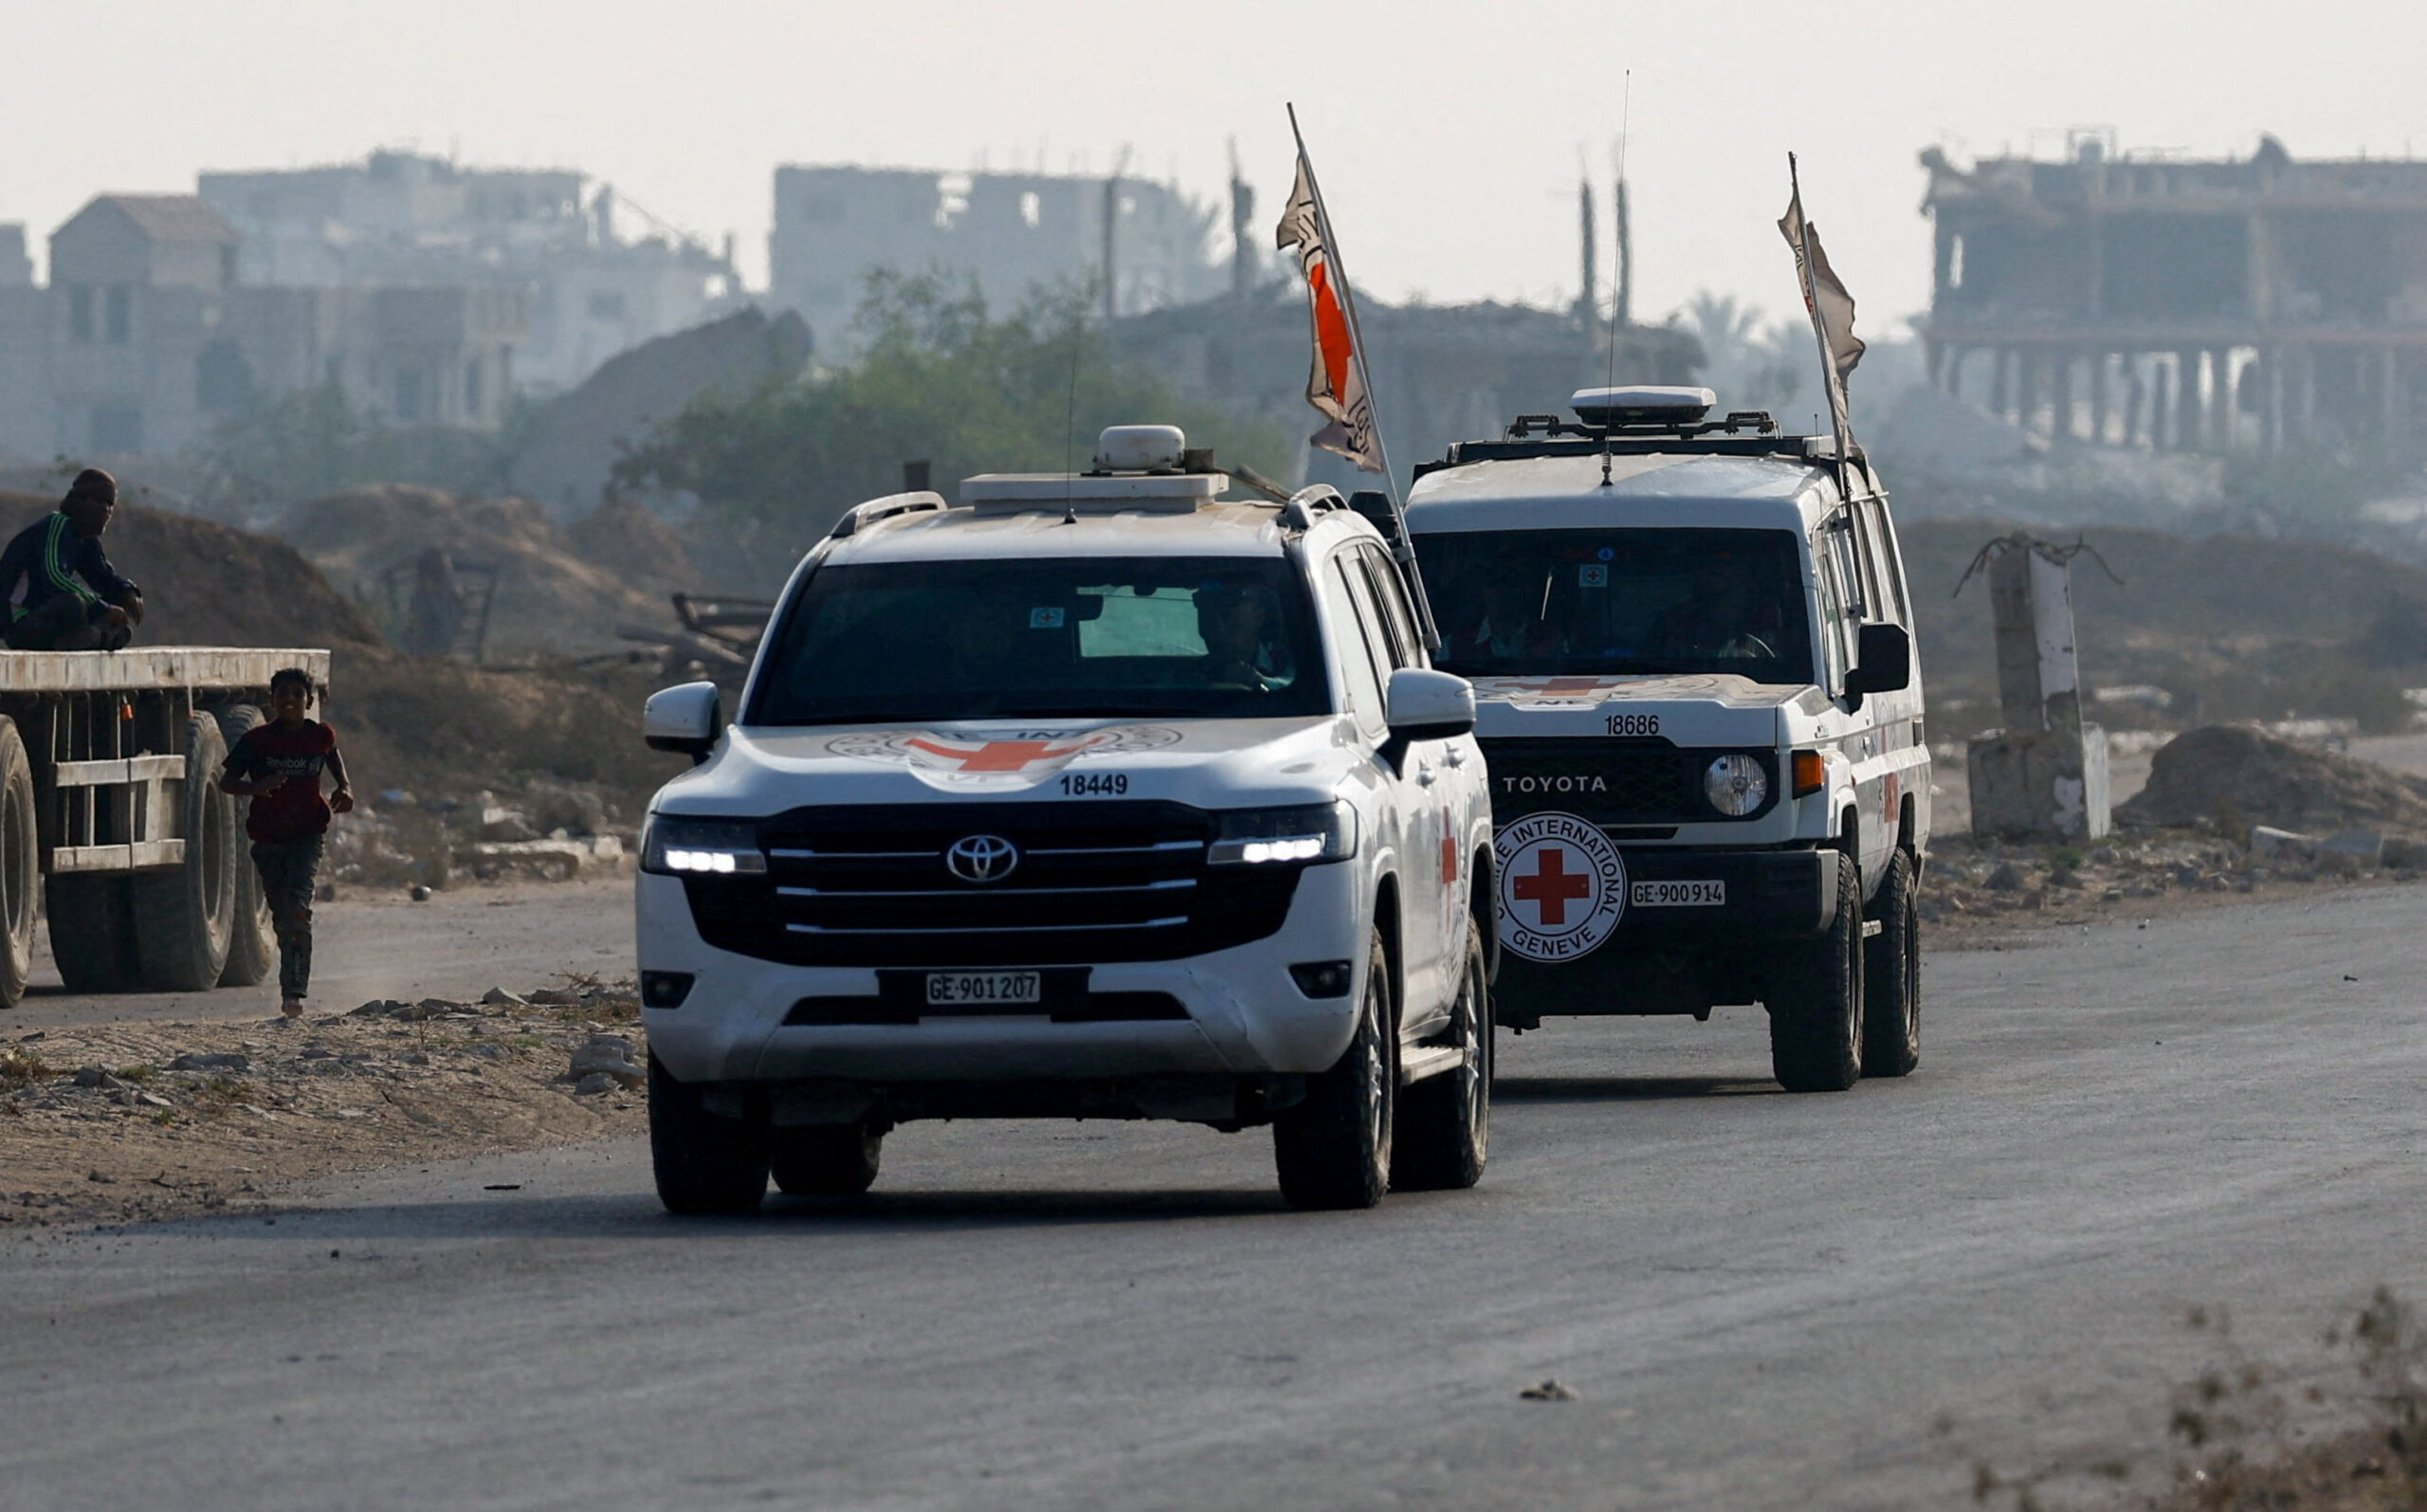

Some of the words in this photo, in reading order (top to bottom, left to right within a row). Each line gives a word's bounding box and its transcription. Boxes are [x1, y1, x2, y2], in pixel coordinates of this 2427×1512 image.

[1605, 715, 1659, 735] 18686
[1060, 774, 1127, 795] 18449
[1503, 775, 1607, 792] TOYOTA
[1512, 819, 1620, 916] INTERNATIONAL
[1513, 926, 1597, 956] GENEVE
